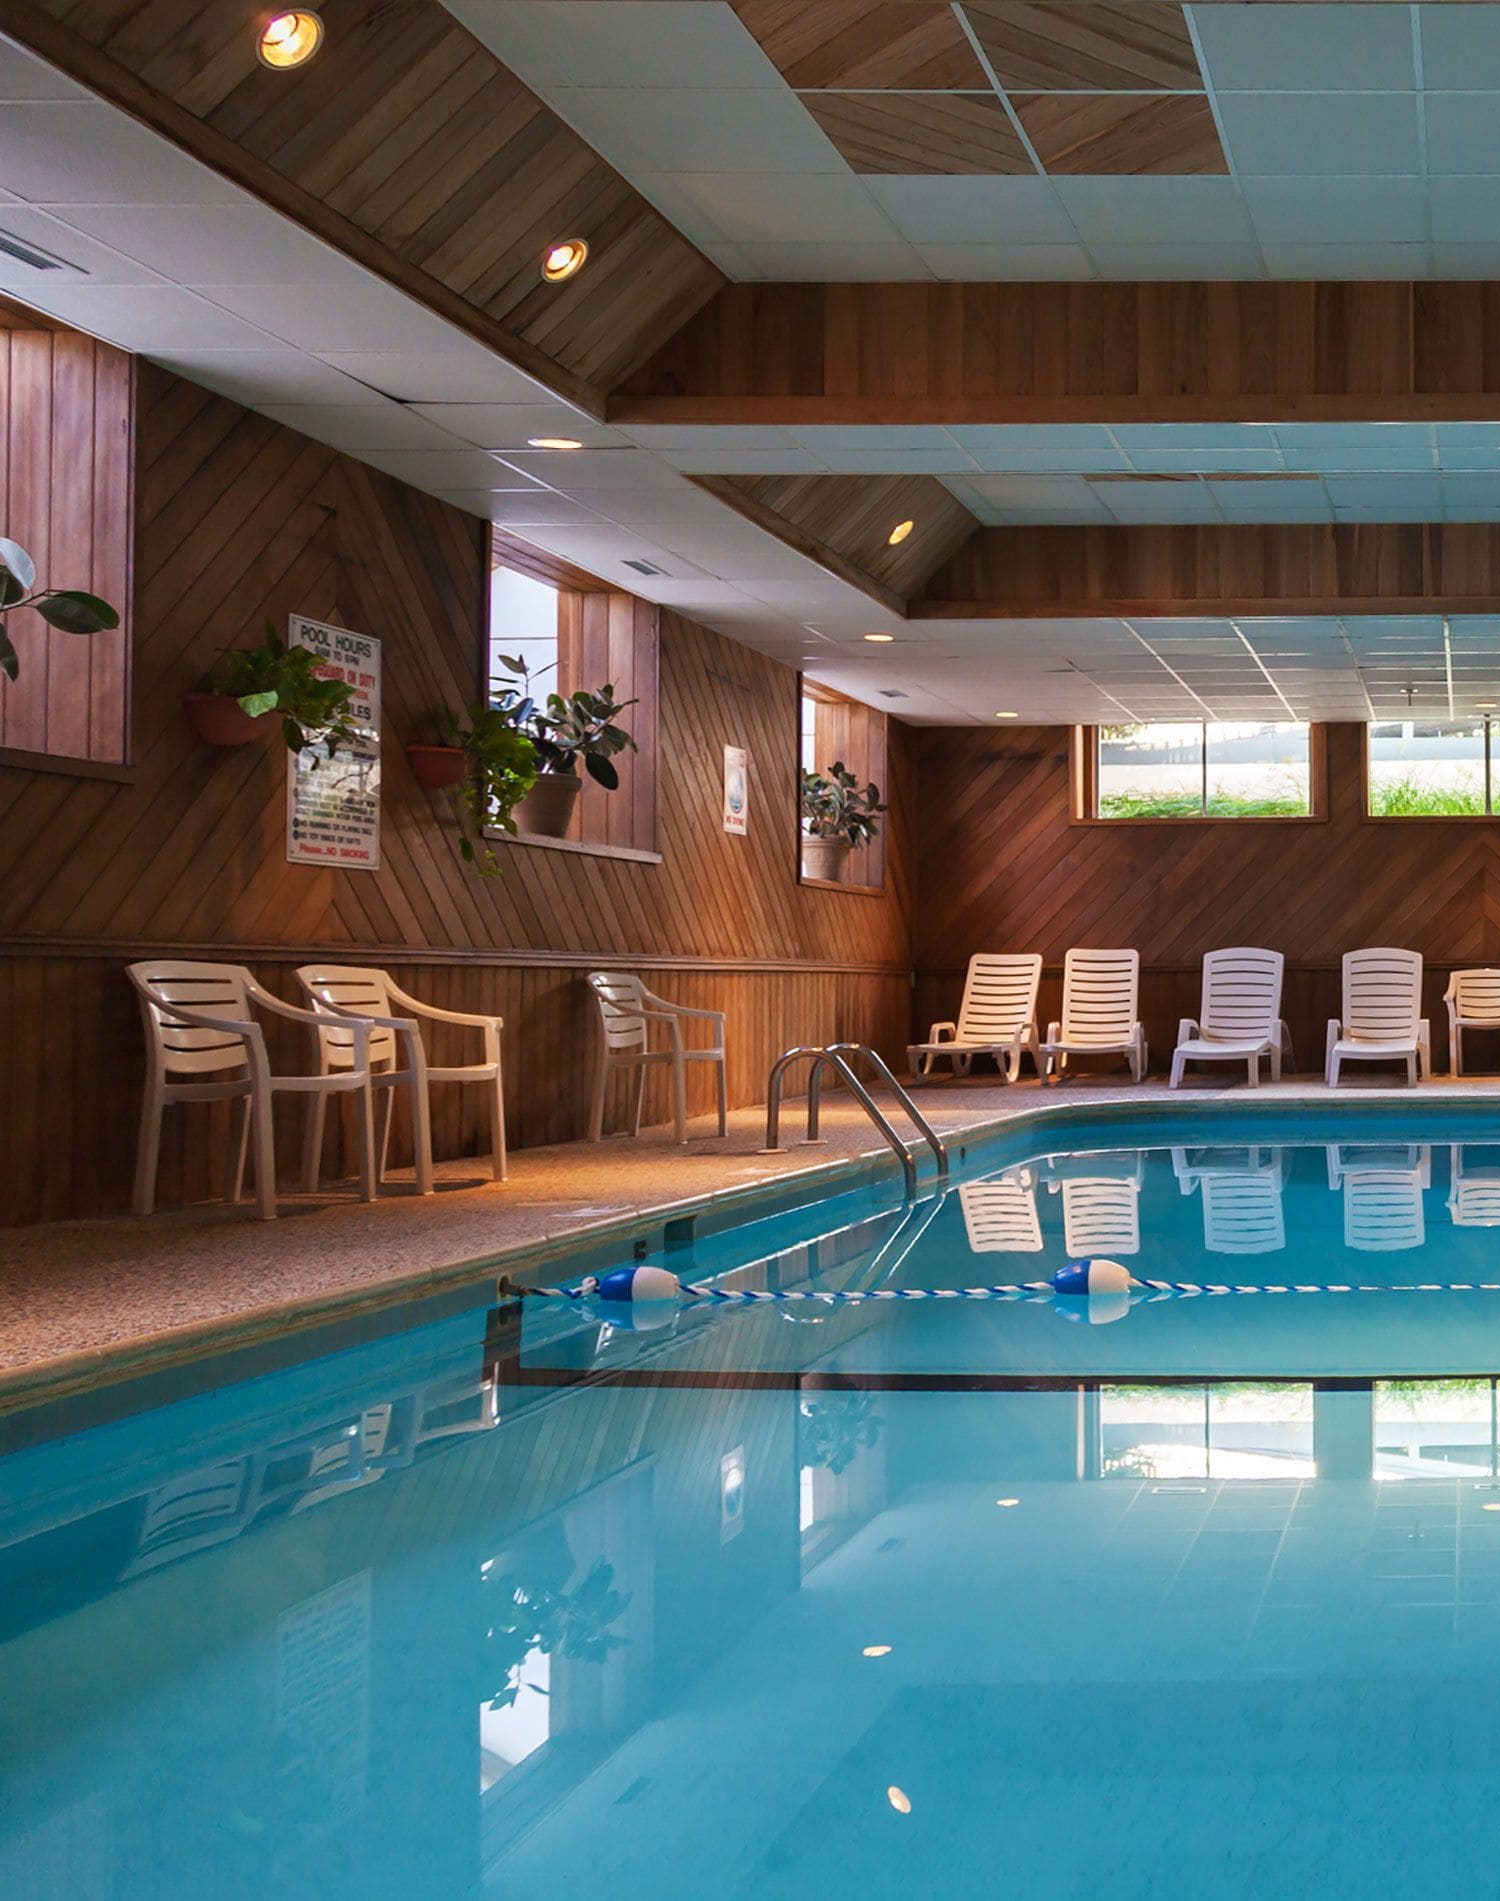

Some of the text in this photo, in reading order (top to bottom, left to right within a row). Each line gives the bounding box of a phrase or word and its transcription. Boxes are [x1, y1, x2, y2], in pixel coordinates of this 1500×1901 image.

[301, 625, 371, 658] POOL HOURS
[333, 650, 342, 661] TO
[360, 673, 376, 690] DUTY
[340, 848, 369, 860] SMOKING
